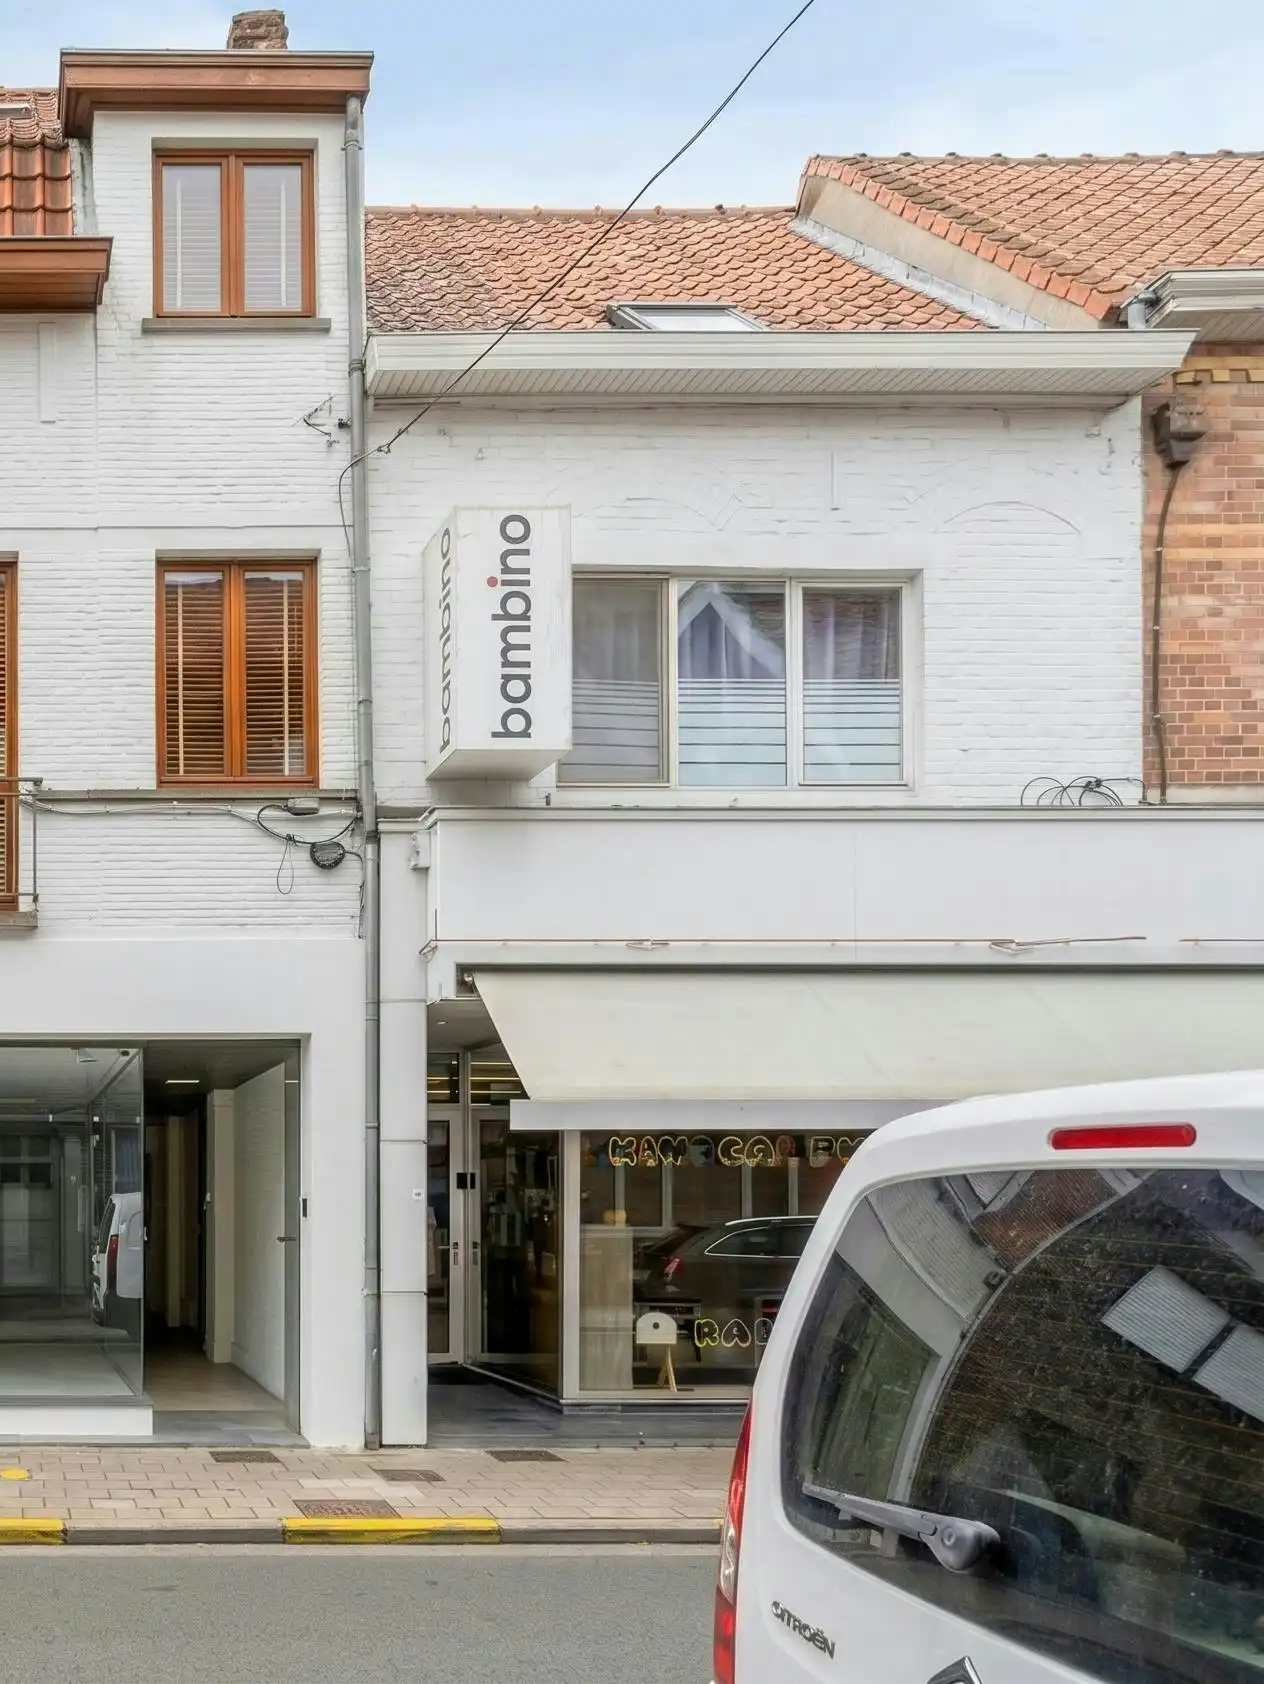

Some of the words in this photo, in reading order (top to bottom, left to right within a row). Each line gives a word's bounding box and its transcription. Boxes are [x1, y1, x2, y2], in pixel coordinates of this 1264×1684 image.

[439, 527, 451, 755] bambino
[487, 514, 532, 739] bambino
[771, 1600, 836, 1660] CITROËN
